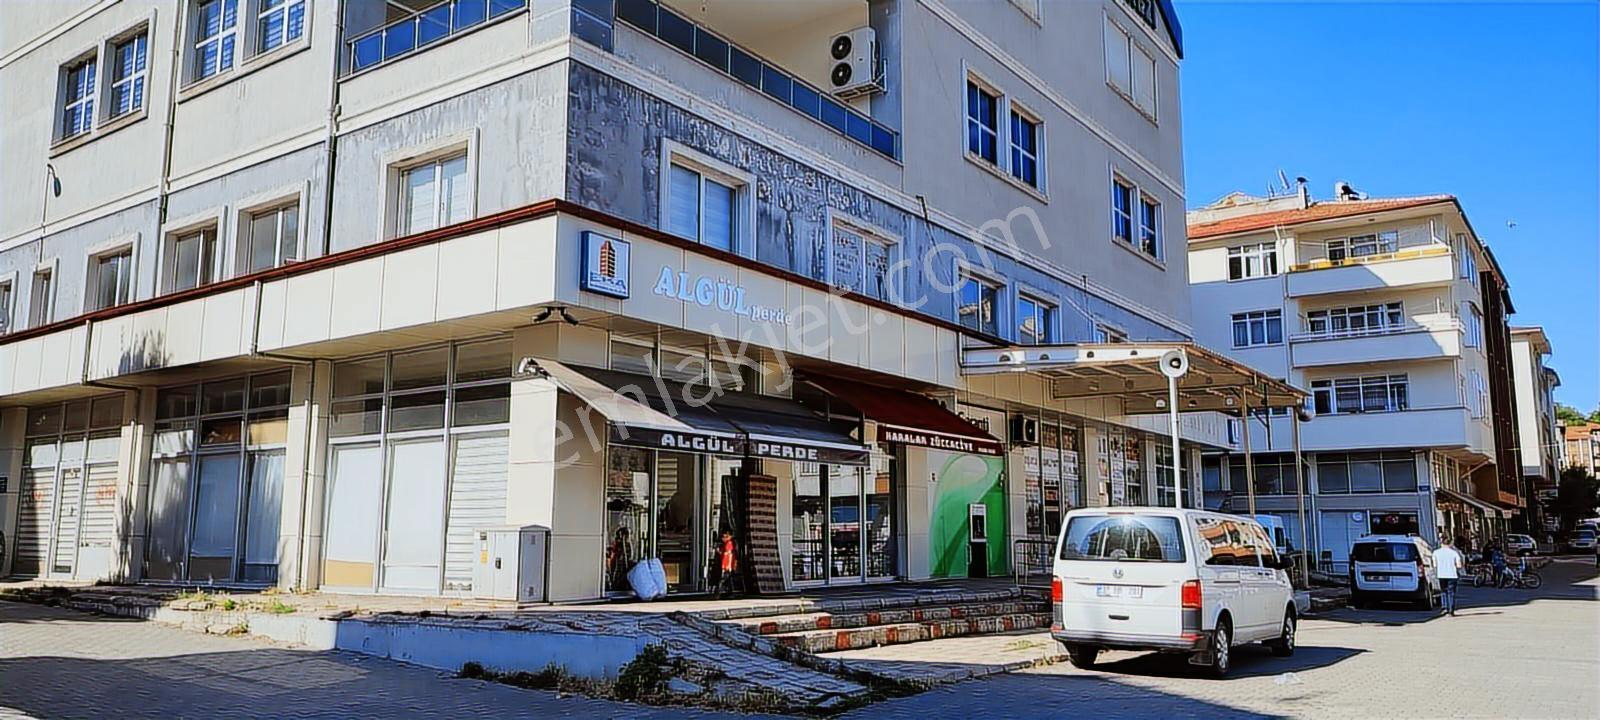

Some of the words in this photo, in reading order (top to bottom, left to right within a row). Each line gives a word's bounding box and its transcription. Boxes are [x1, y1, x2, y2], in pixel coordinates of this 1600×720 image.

[653, 265, 749, 316] ALGÜL
[750, 304, 792, 326] perde
[660, 432, 734, 452] ALGÜL
[757, 442, 818, 460] PERDE
